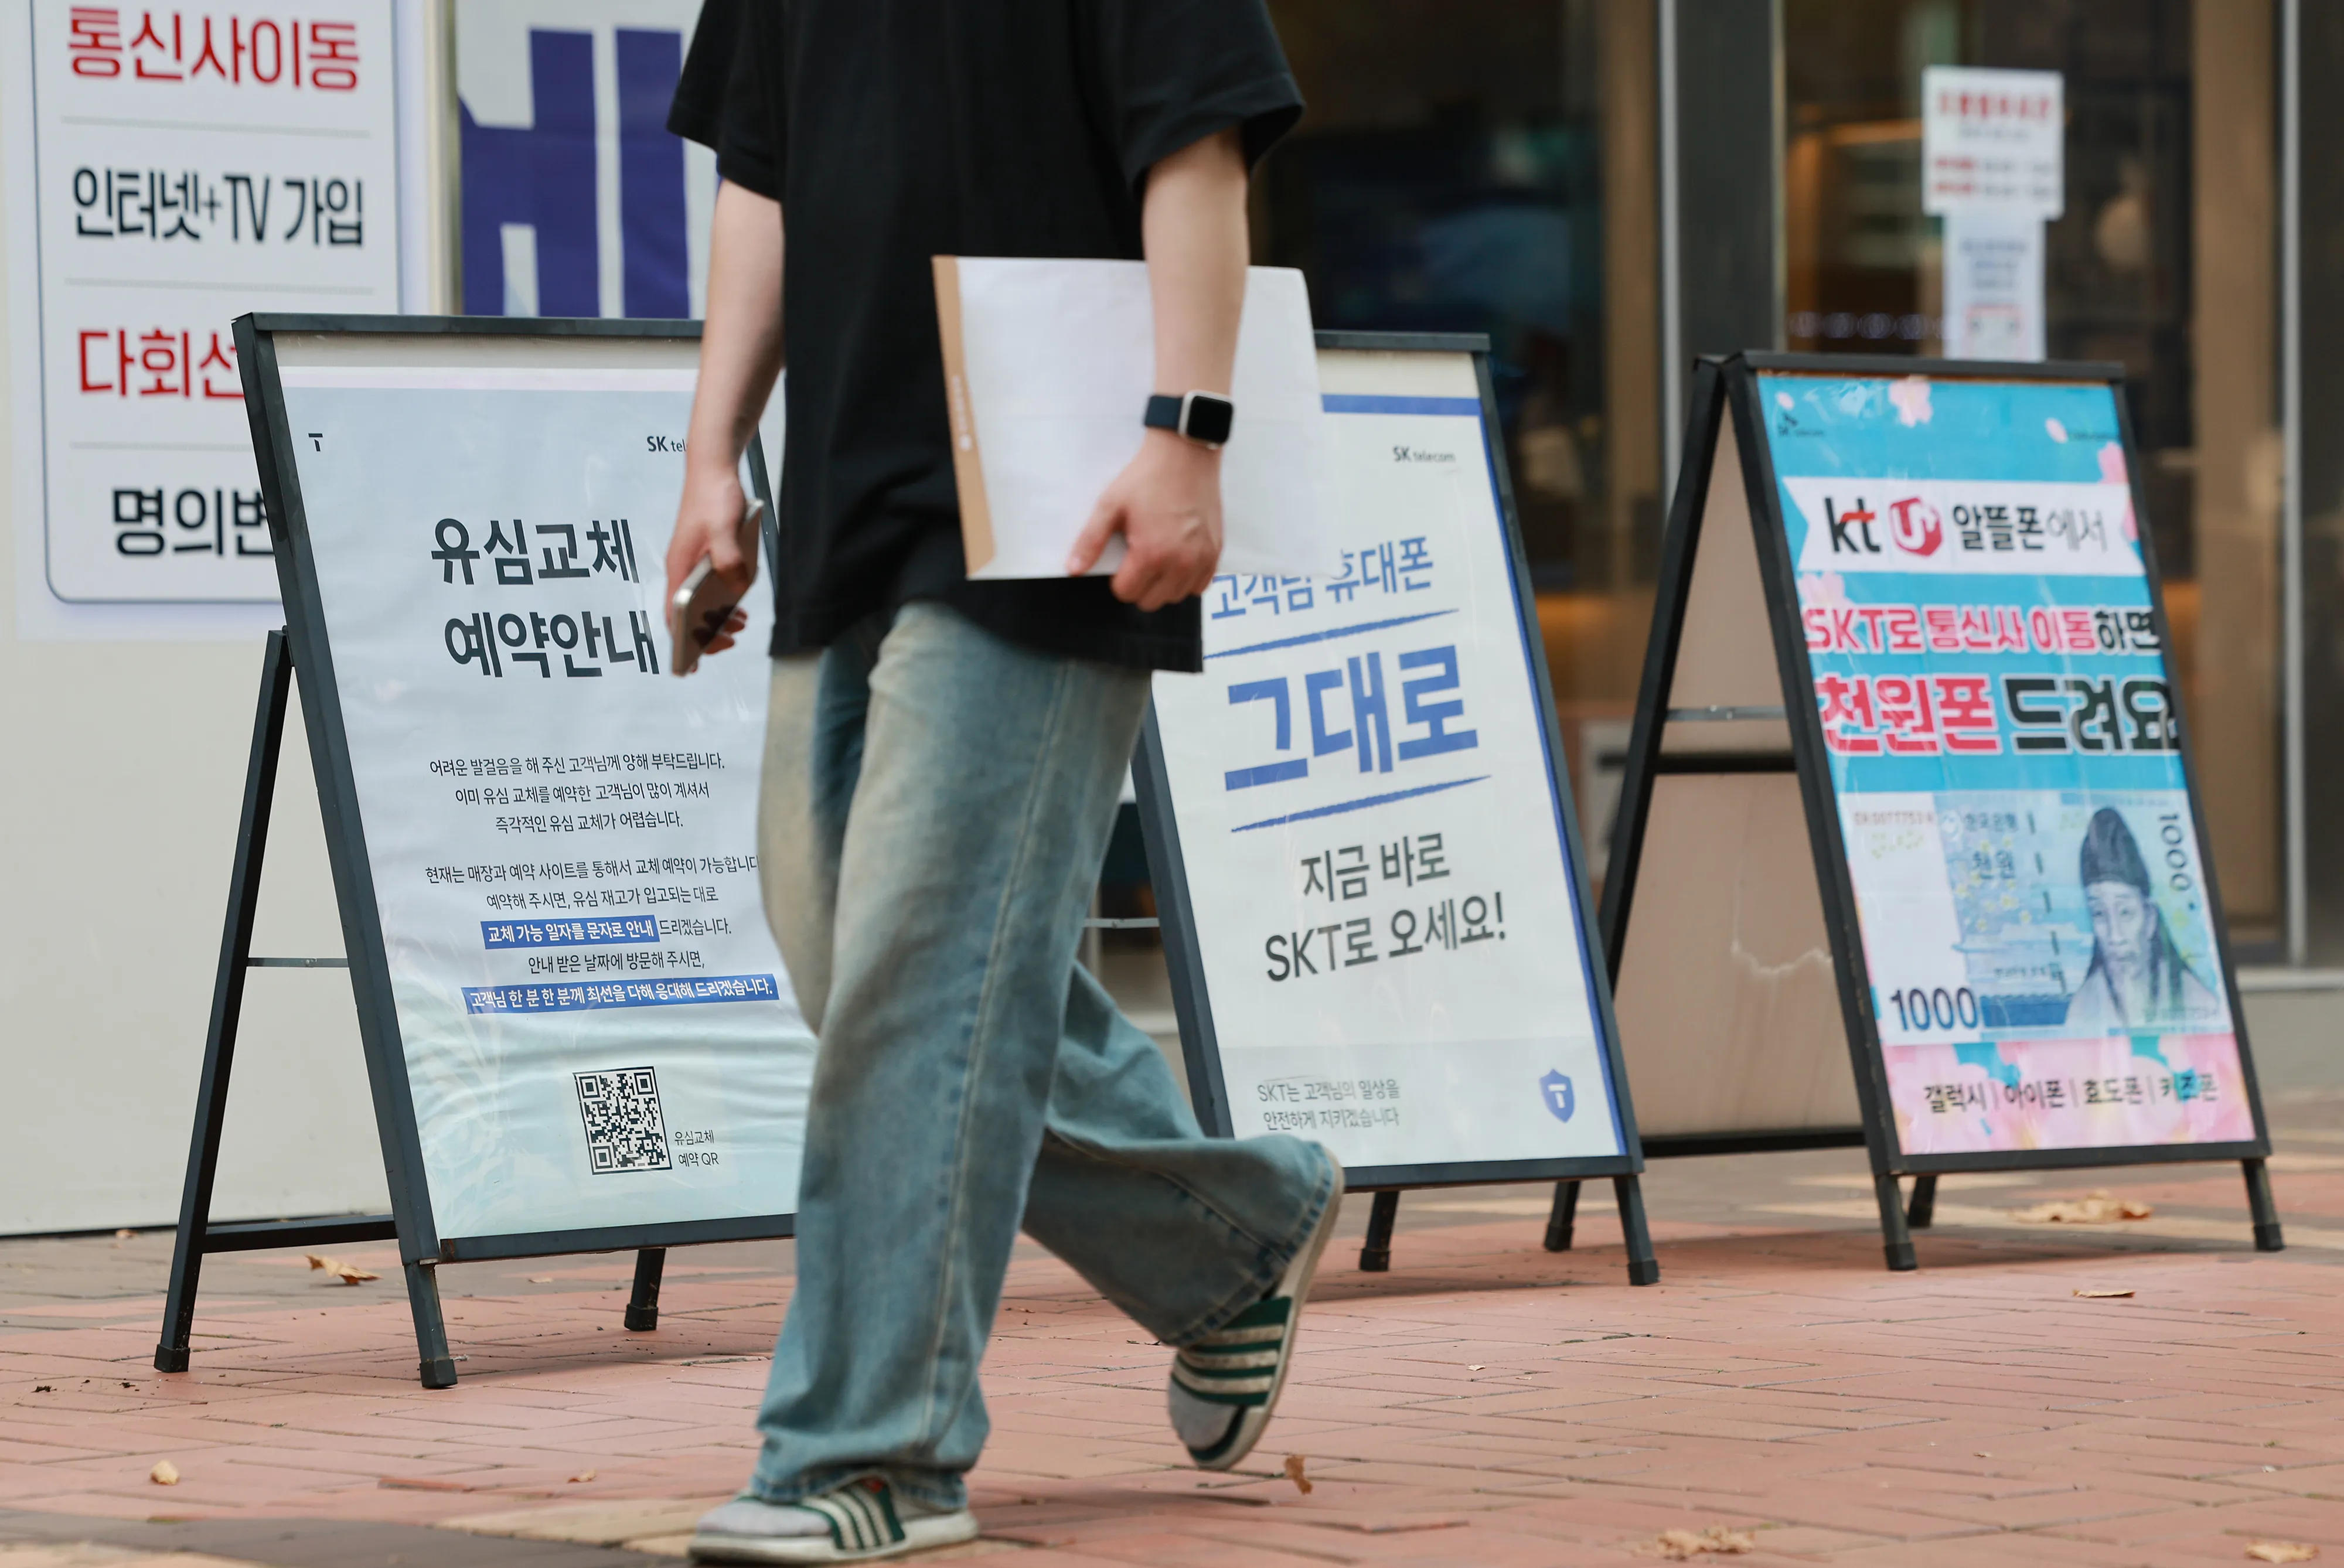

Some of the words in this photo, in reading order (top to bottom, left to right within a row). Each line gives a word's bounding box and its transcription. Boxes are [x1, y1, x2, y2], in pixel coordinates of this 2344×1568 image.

[68, 6, 360, 91] 통신사이동
[73, 166, 271, 243] 인터넷+TV
[284, 178, 364, 246] 가입
[647, 436, 669, 452] SK
[670, 438, 688, 452] tel
[1393, 445, 1412, 462] SK
[1825, 498, 1880, 552] kt
[431, 518, 639, 585] 유심교체
[1804, 607, 1922, 650] SKT로
[445, 611, 659, 677] 예약안내
[1224, 644, 1478, 791] 그대로
[1819, 676, 2000, 754] 천원폰
[2004, 677, 2181, 751] 드려요
[430, 759, 468, 776] 어려운
[470, 758, 522, 776] 발걸음을
[525, 757, 540, 774] 해
[542, 757, 565, 773] 주신
[569, 754, 621, 773] 고객님께
[623, 754, 649, 771] 양해
[652, 752, 724, 770] 부탁드립니다.
[455, 788, 480, 805] 이미
[483, 788, 509, 805] 유심
[513, 786, 550, 803] 교체를
[553, 785, 591, 803] 예약한
[595, 783, 645, 800] 고객님이
[647, 782, 672, 799] 많이
[674, 782, 710, 798] 계셔서
[496, 815, 547, 834] 즉각적인
[550, 815, 574, 832] 유심
[578, 813, 616, 830] 교체가
[619, 811, 683, 828] 어렵습니다.
[425, 866, 465, 884] 현재는
[468, 864, 506, 882] 매장과
[509, 863, 535, 881] 예약
[539, 861, 588, 880] 사이트를
[592, 859, 632, 878] 통해서
[635, 858, 660, 875] 교체
[662, 857, 697, 874] 예약이
[1300, 845, 1370, 902] 지금
[1381, 833, 1450, 887] 바로
[486, 894, 527, 910] 예약해
[529, 892, 570, 909] 주시면,
[573, 890, 598, 907] 유심
[601, 887, 640, 906] 재고가
[644, 886, 691, 904] 입고되는
[693, 885, 719, 902] 대로
[488, 925, 515, 942] 교체
[516, 924, 543, 942] 가능
[546, 923, 585, 942] 일자를
[587, 921, 625, 939] 문자로
[626, 919, 655, 938] 안내
[659, 918, 731, 936] 드리겠습니다.
[1265, 917, 1379, 981] SKT로
[1389, 891, 1506, 959] 오세요!
[529, 956, 554, 974] 안내
[557, 955, 581, 973] 받은
[585, 953, 623, 972] 날짜에
[626, 951, 665, 970] 방문해
[667, 950, 705, 969] 주시면,
[470, 990, 507, 1008] 고객님
[508, 990, 523, 1008] 한
[526, 989, 540, 1007] 분
[541, 988, 554, 1006] 한
[557, 987, 585, 1006] 분께
[587, 984, 626, 1003] 최선을
[627, 983, 655, 1001] 다해
[655, 982, 695, 1000] 응대해
[696, 977, 773, 996] 드리겠습니다.
[1890, 987, 1979, 1031] 1000
[1258, 1082, 1300, 1103] SKT는
[1304, 1081, 1357, 1101] 고객님의
[1358, 1079, 1400, 1100] 일상을
[1923, 1081, 1986, 1113] 갤럭시
[2004, 1079, 2064, 1109] 아이폰
[2084, 1077, 2142, 1105] 효도폰
[1263, 1110, 1317, 1131] 안전하게
[1318, 1107, 1399, 1129] 지키겠습니다
[674, 1130, 714, 1146] 유심교체
[679, 1153, 699, 1167] 예약
[701, 1153, 719, 1165] QR
